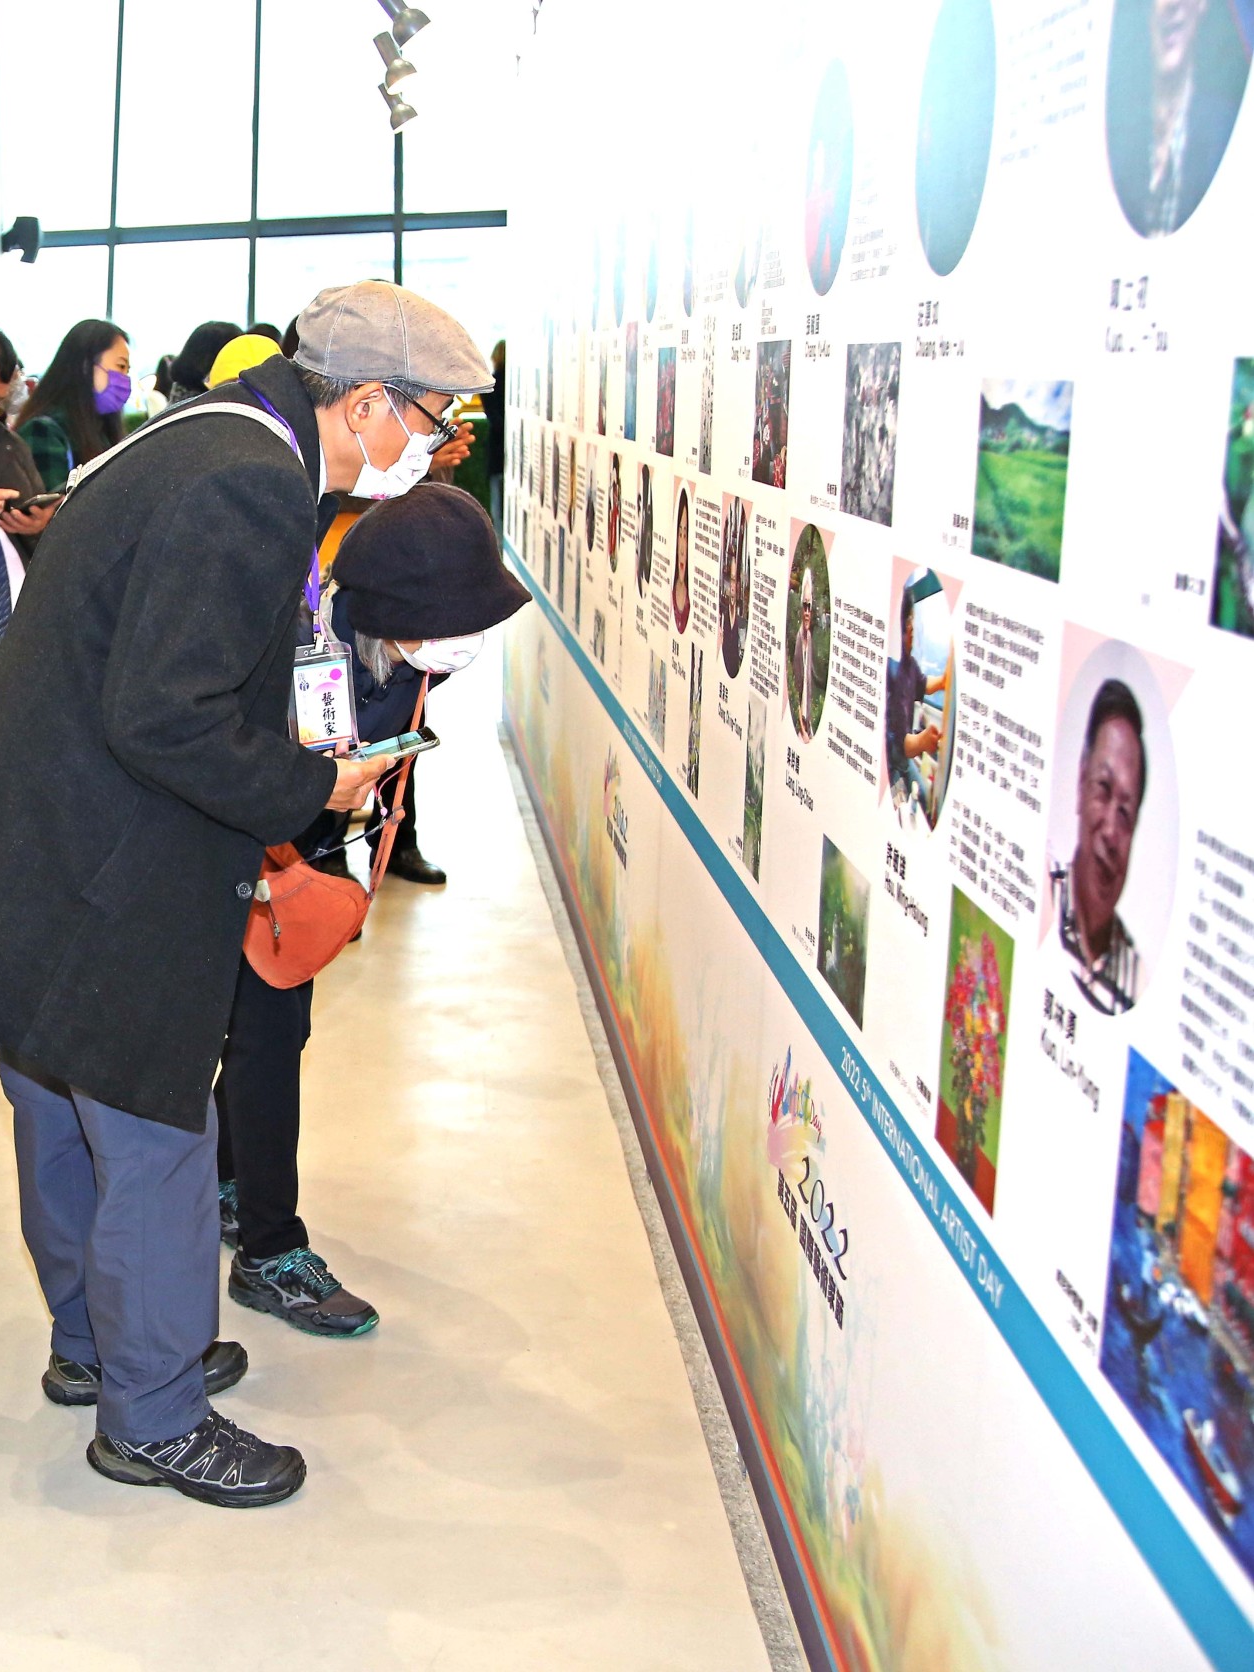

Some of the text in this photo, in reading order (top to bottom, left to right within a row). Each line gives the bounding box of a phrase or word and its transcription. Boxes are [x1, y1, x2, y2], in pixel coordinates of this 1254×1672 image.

[321, 691, 338, 737] 藝術家
[797, 1155, 848, 1281] 2022
[840, 1045, 861, 1093] 2022
[871, 1097, 940, 1216] INTERNATIONAL
[940, 1201, 978, 1270] ARTIST
[977, 1253, 1005, 1309] DAY
